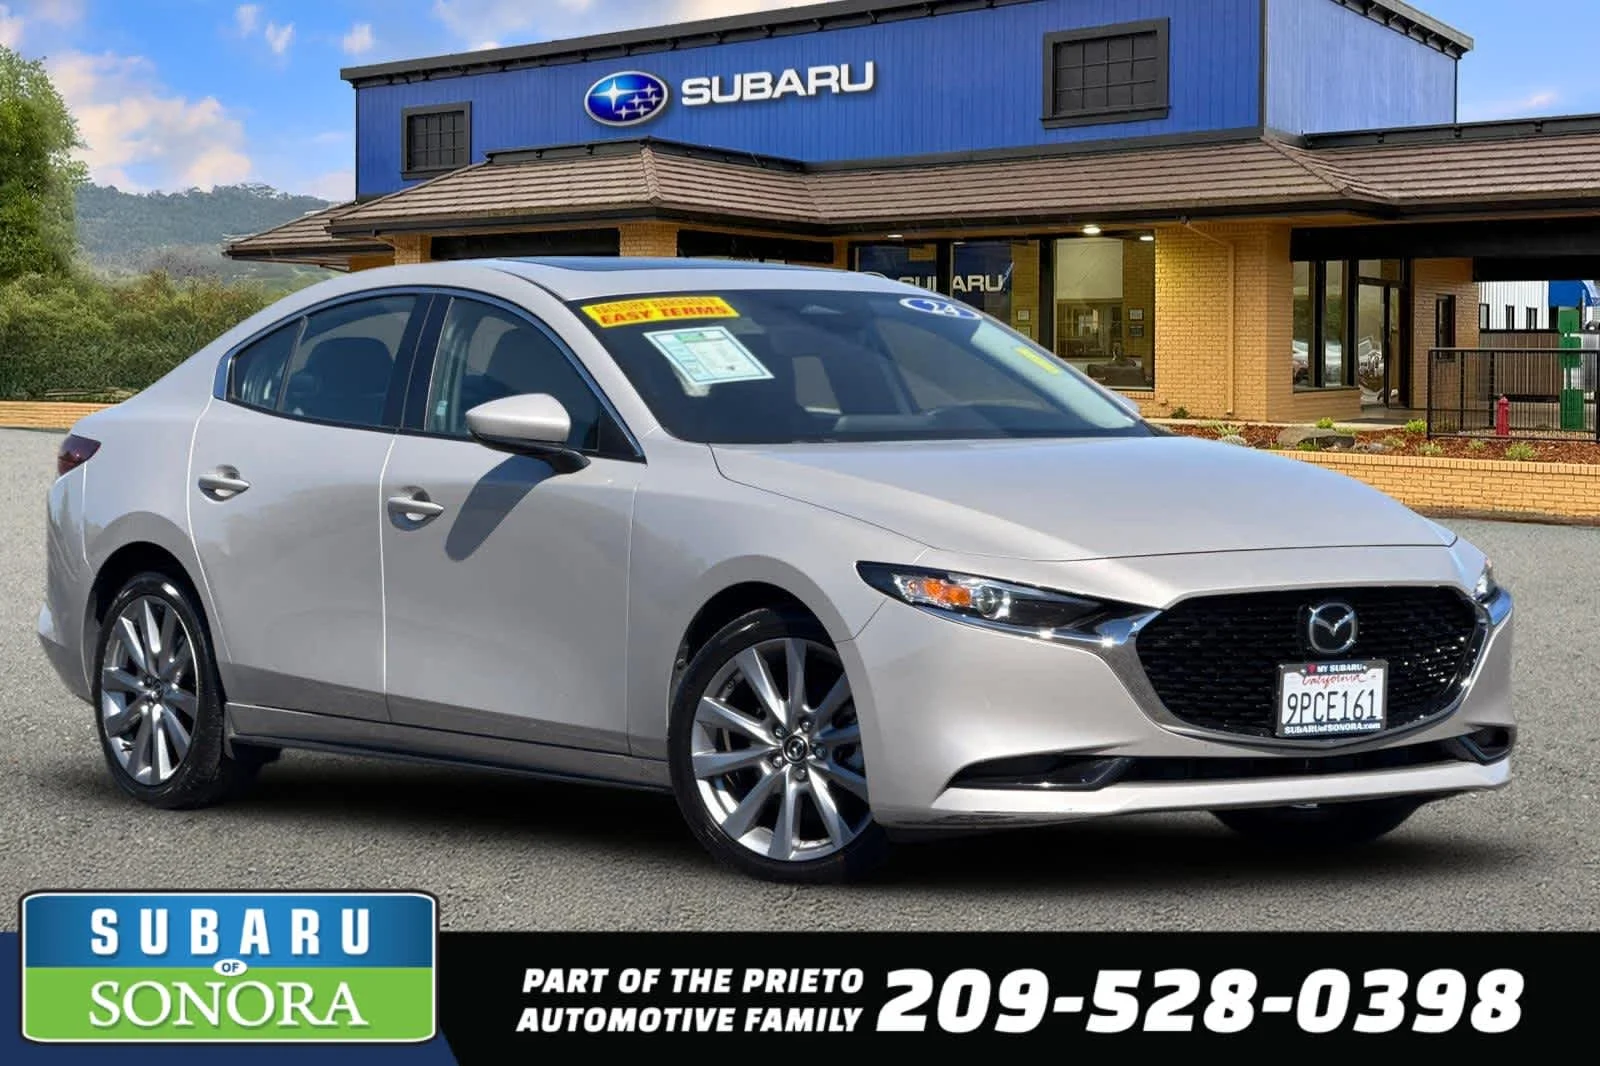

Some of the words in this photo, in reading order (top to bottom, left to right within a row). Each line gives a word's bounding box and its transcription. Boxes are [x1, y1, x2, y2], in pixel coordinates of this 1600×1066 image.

[681, 60, 875, 106] SUBARU
[601, 309, 650, 324] EASY
[661, 305, 728, 318] TERMS
[1317, 664, 1329, 673] MY
[1330, 663, 1363, 672] SUBARU
[1286, 688, 1377, 725] 9PCE161
